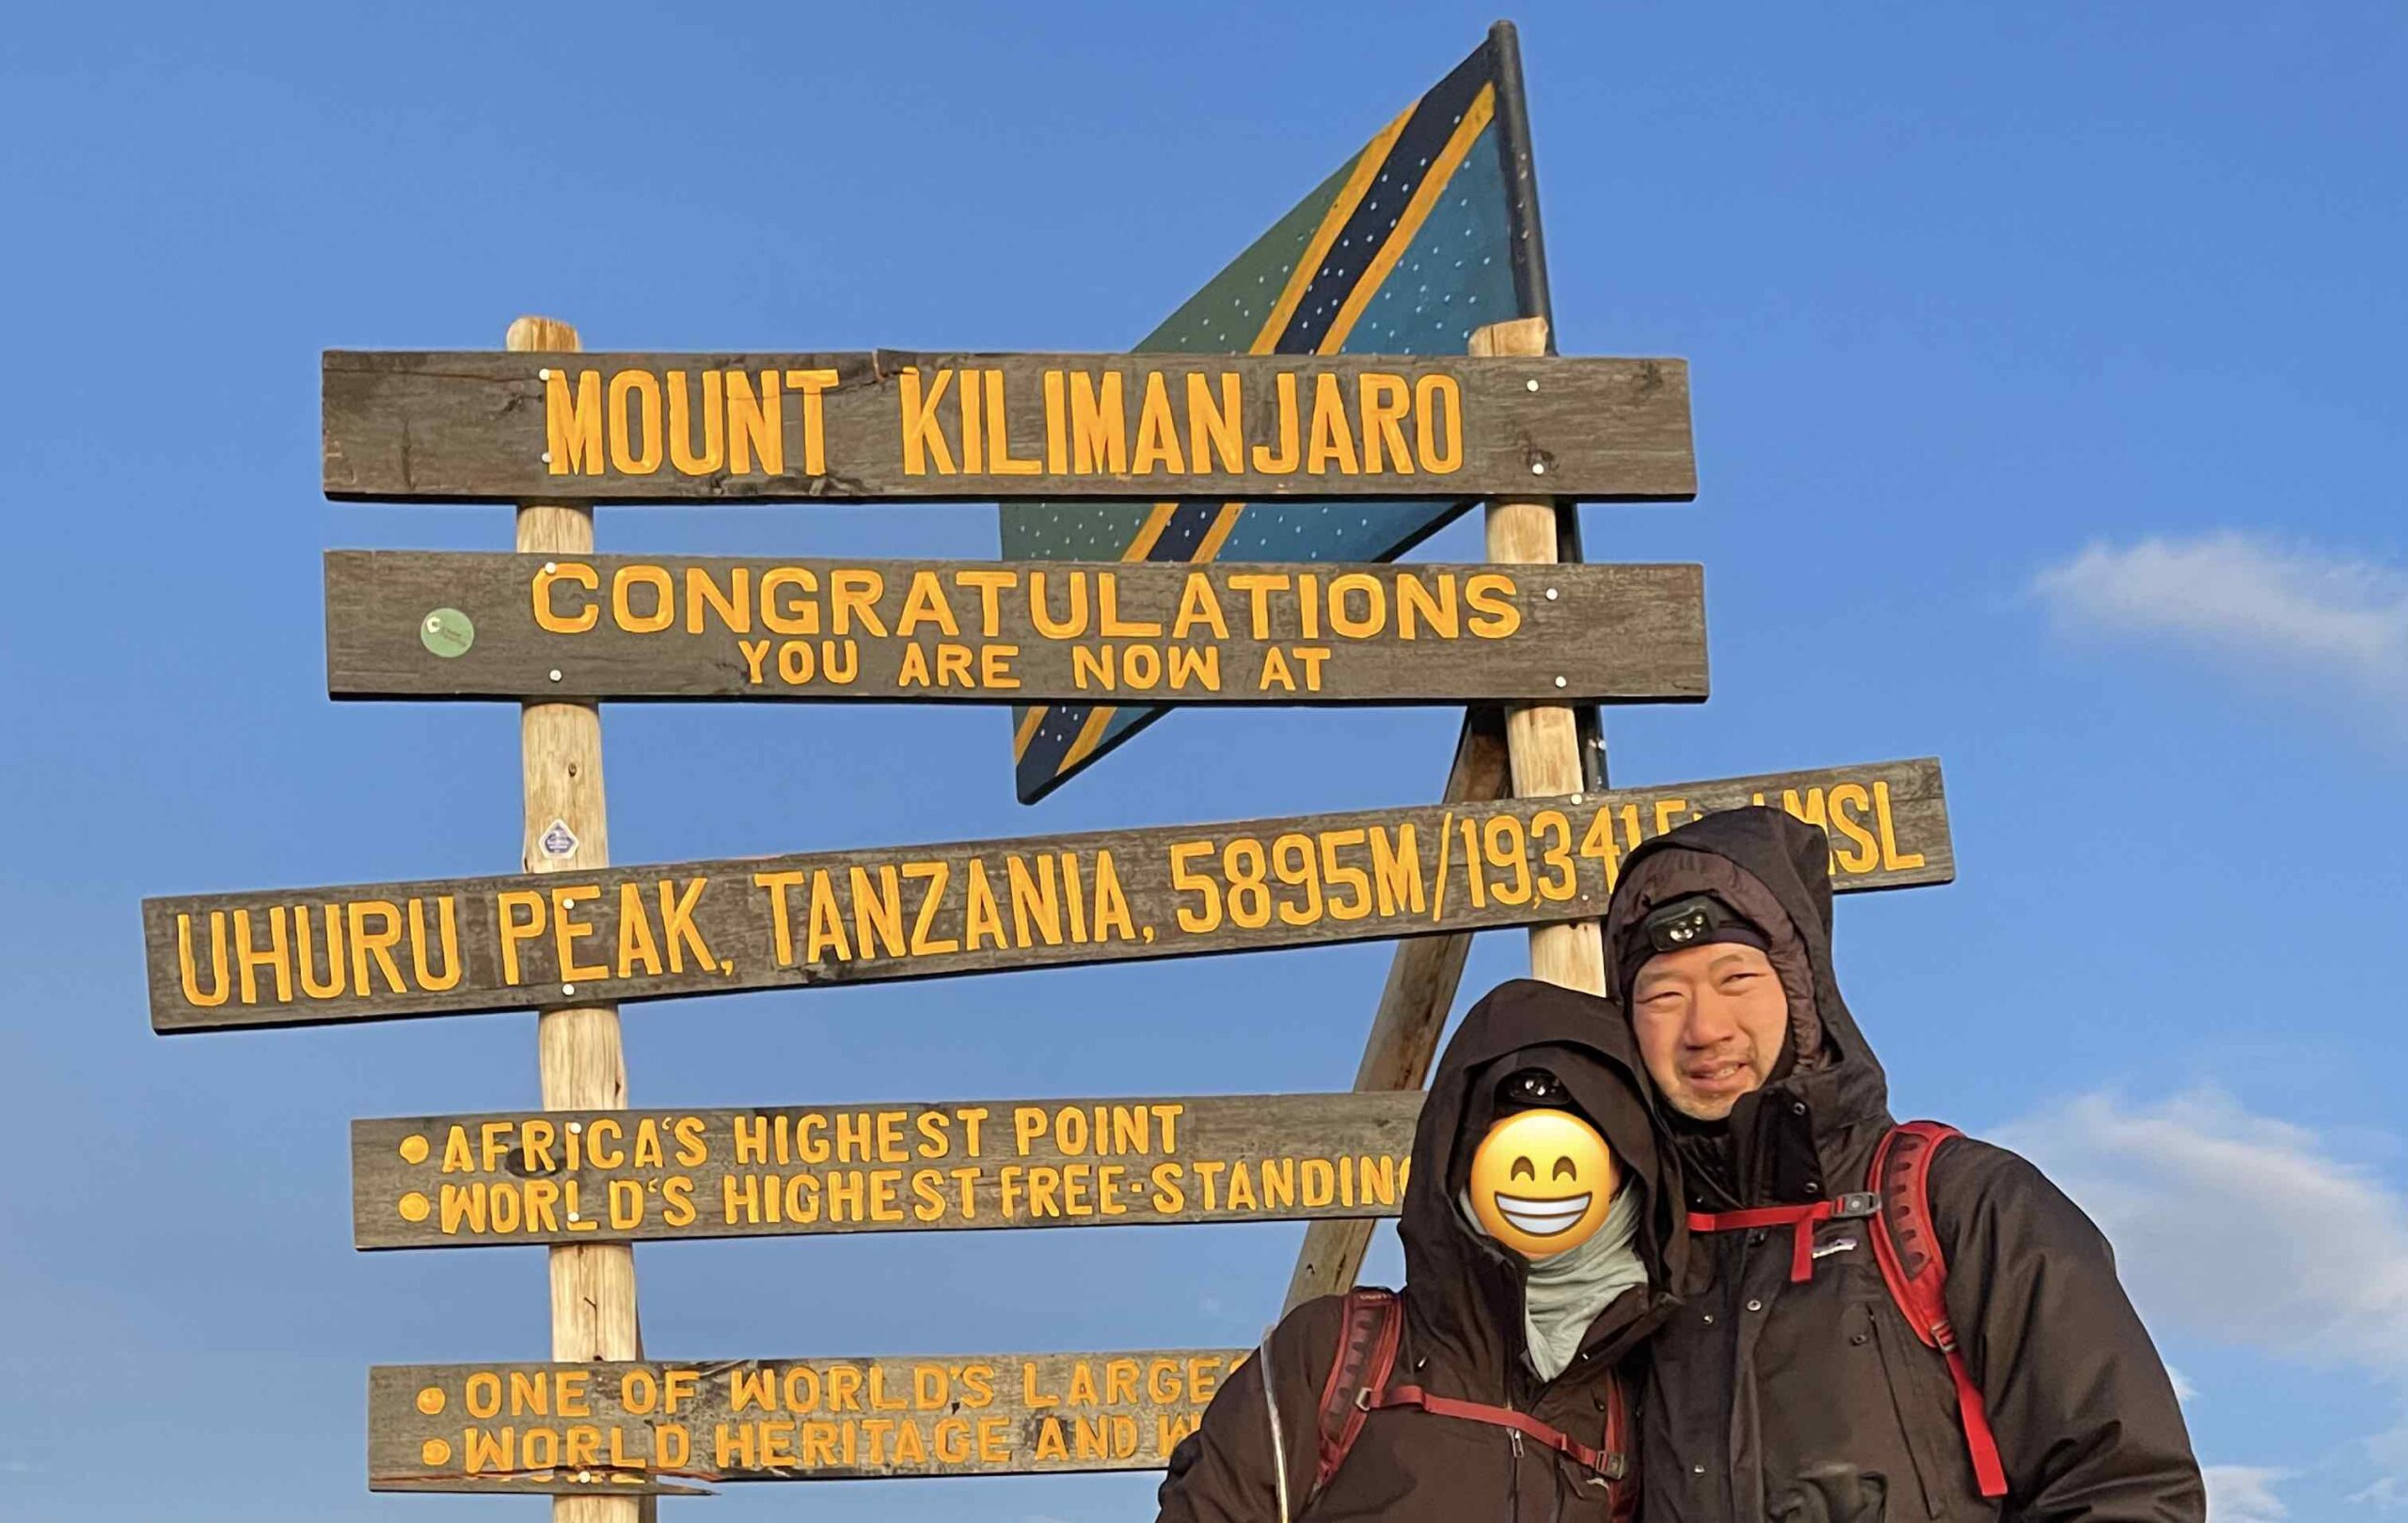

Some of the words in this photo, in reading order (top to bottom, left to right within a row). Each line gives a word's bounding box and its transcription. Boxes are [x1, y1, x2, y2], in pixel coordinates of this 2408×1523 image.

[546, 368, 840, 477] MOUNT
[898, 366, 1465, 477] KILIMANJARO
[531, 562, 1522, 641] CONGRATULATIONS
[739, 640, 860, 687] YOU
[897, 642, 1022, 690] ARE
[1071, 643, 1222, 691] NOW
[1259, 645, 1331, 691] AT
[177, 895, 463, 1008] UHURU
[498, 876, 735, 987] PEAK,
[753, 849, 1156, 967] TANZANIA,
[440, 1115, 709, 1175] AFRICA'S
[734, 1107, 990, 1166] HIGHEST
[1013, 1103, 1184, 1158] POINT
[438, 1171, 698, 1235] WORLD'S
[721, 1166, 983, 1226] HIGHEST
[465, 1369, 594, 1421] ONE
[619, 1367, 703, 1418] OF
[727, 1362, 996, 1417] WORLD'S
[1022, 1355, 1247, 1410] LARGE
[463, 1420, 693, 1483] WORLD
[712, 1416, 1013, 1471] HERITAGE
[1035, 1414, 1140, 1465] AND
[1156, 1411, 1203, 1460] W
